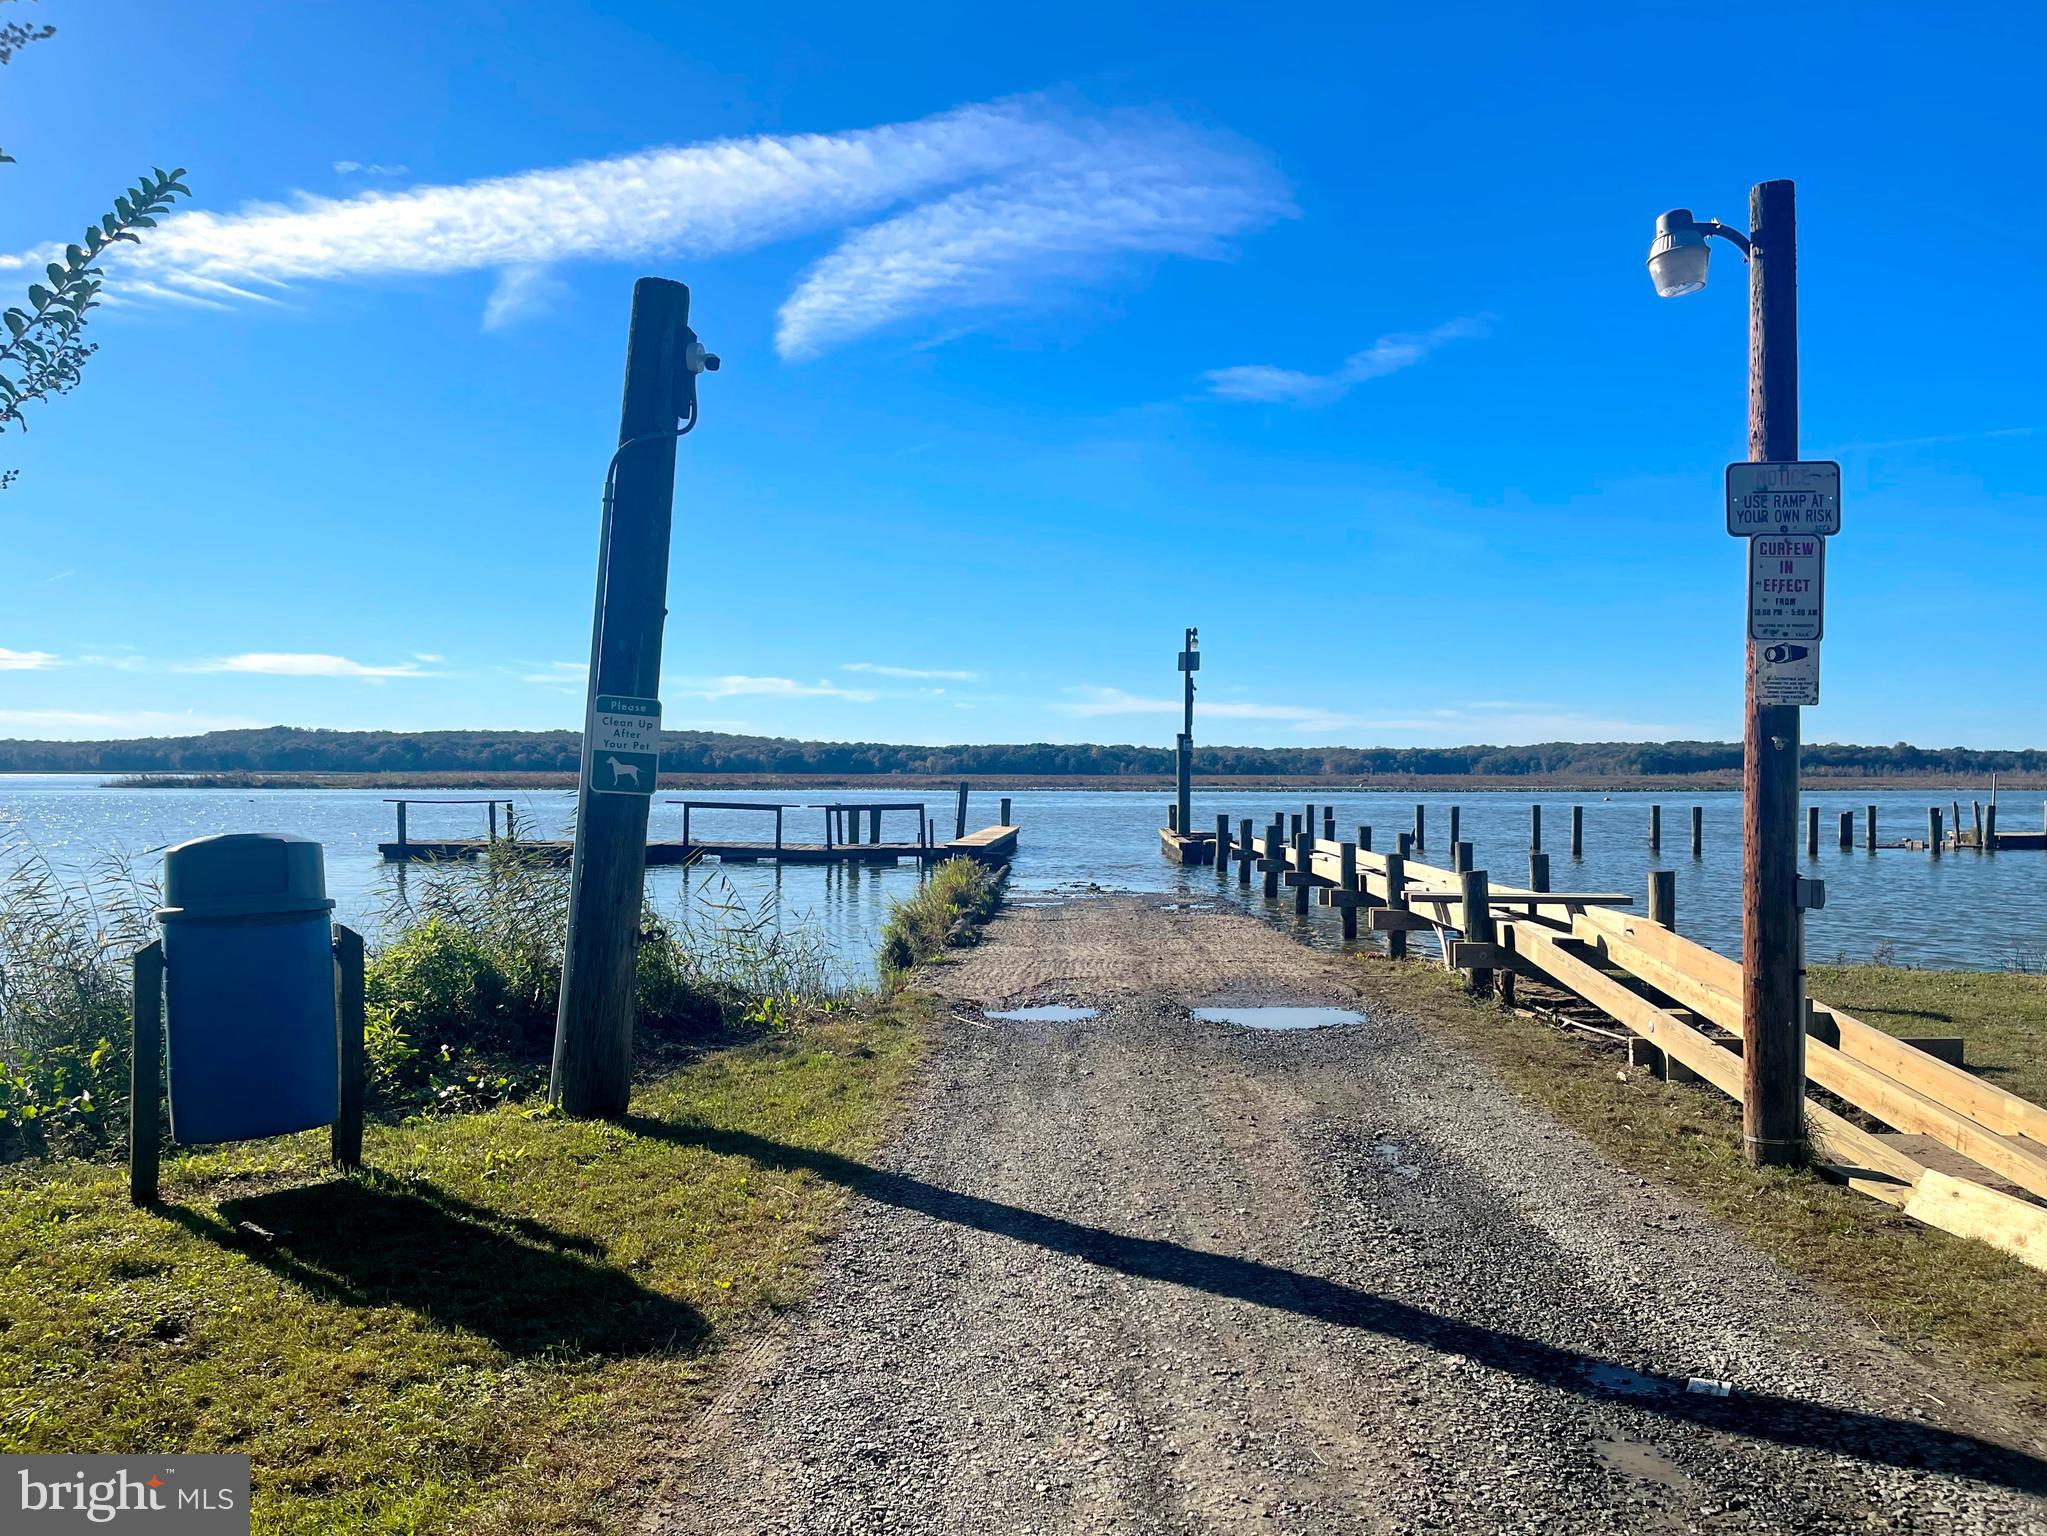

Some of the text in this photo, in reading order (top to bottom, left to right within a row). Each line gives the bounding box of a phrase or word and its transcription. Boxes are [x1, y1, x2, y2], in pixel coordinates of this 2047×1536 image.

[1756, 468, 1811, 486] NOTICE
[1744, 494, 1825, 509] USE RAMP AT
[1737, 509, 1833, 524] YOUR OWN RISK
[1760, 542, 1814, 556] CURFEW
[1779, 560, 1793, 574] IN
[1763, 579, 1811, 592] EFFECT
[1775, 598, 1796, 606] FROM
[1773, 608, 1783, 616] PM
[1807, 608, 1818, 616] AM
[611, 701, 648, 712] Please
[602, 716, 654, 731] Clean Up
[613, 729, 641, 739] After
[603, 739, 650, 751] Your Pet
